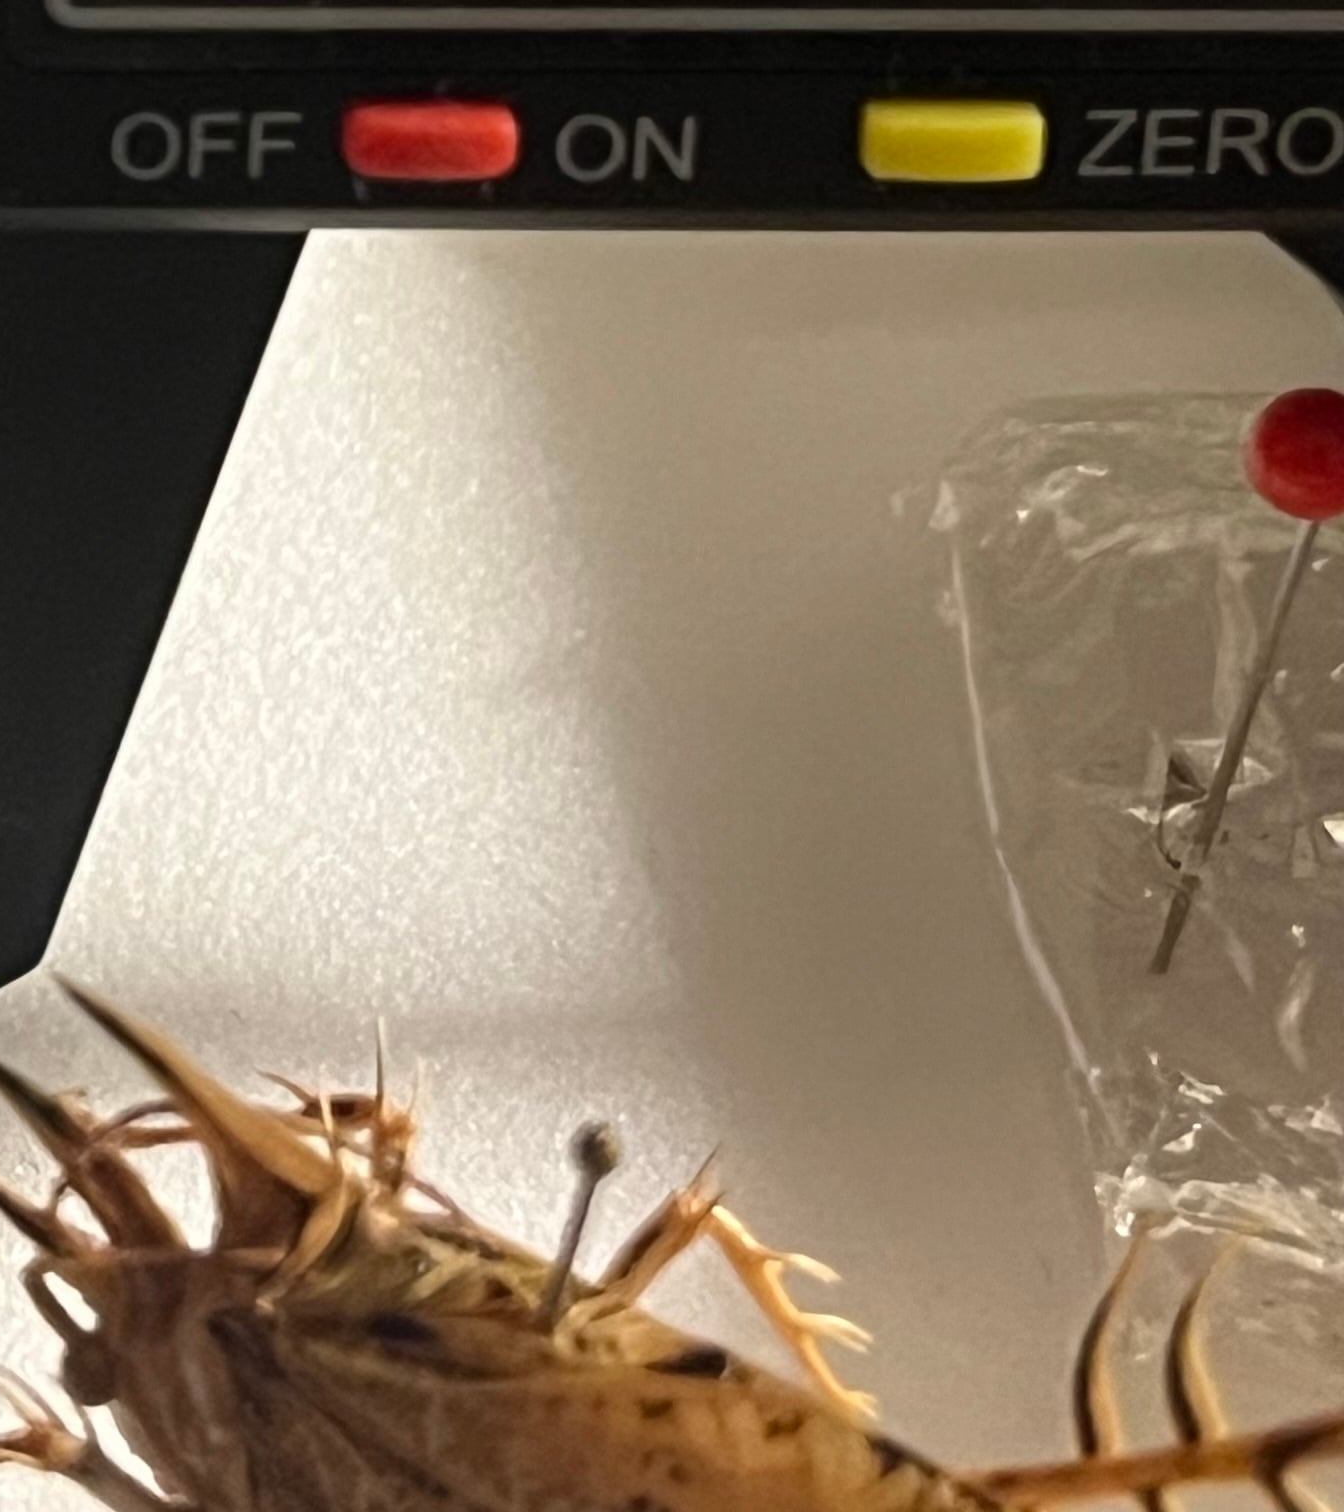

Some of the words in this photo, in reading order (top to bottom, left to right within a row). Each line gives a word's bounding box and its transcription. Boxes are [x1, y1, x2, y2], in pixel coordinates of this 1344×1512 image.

[110, 109, 304, 182] OFF
[554, 112, 698, 184] ON
[1076, 105, 1344, 179] ZERO
